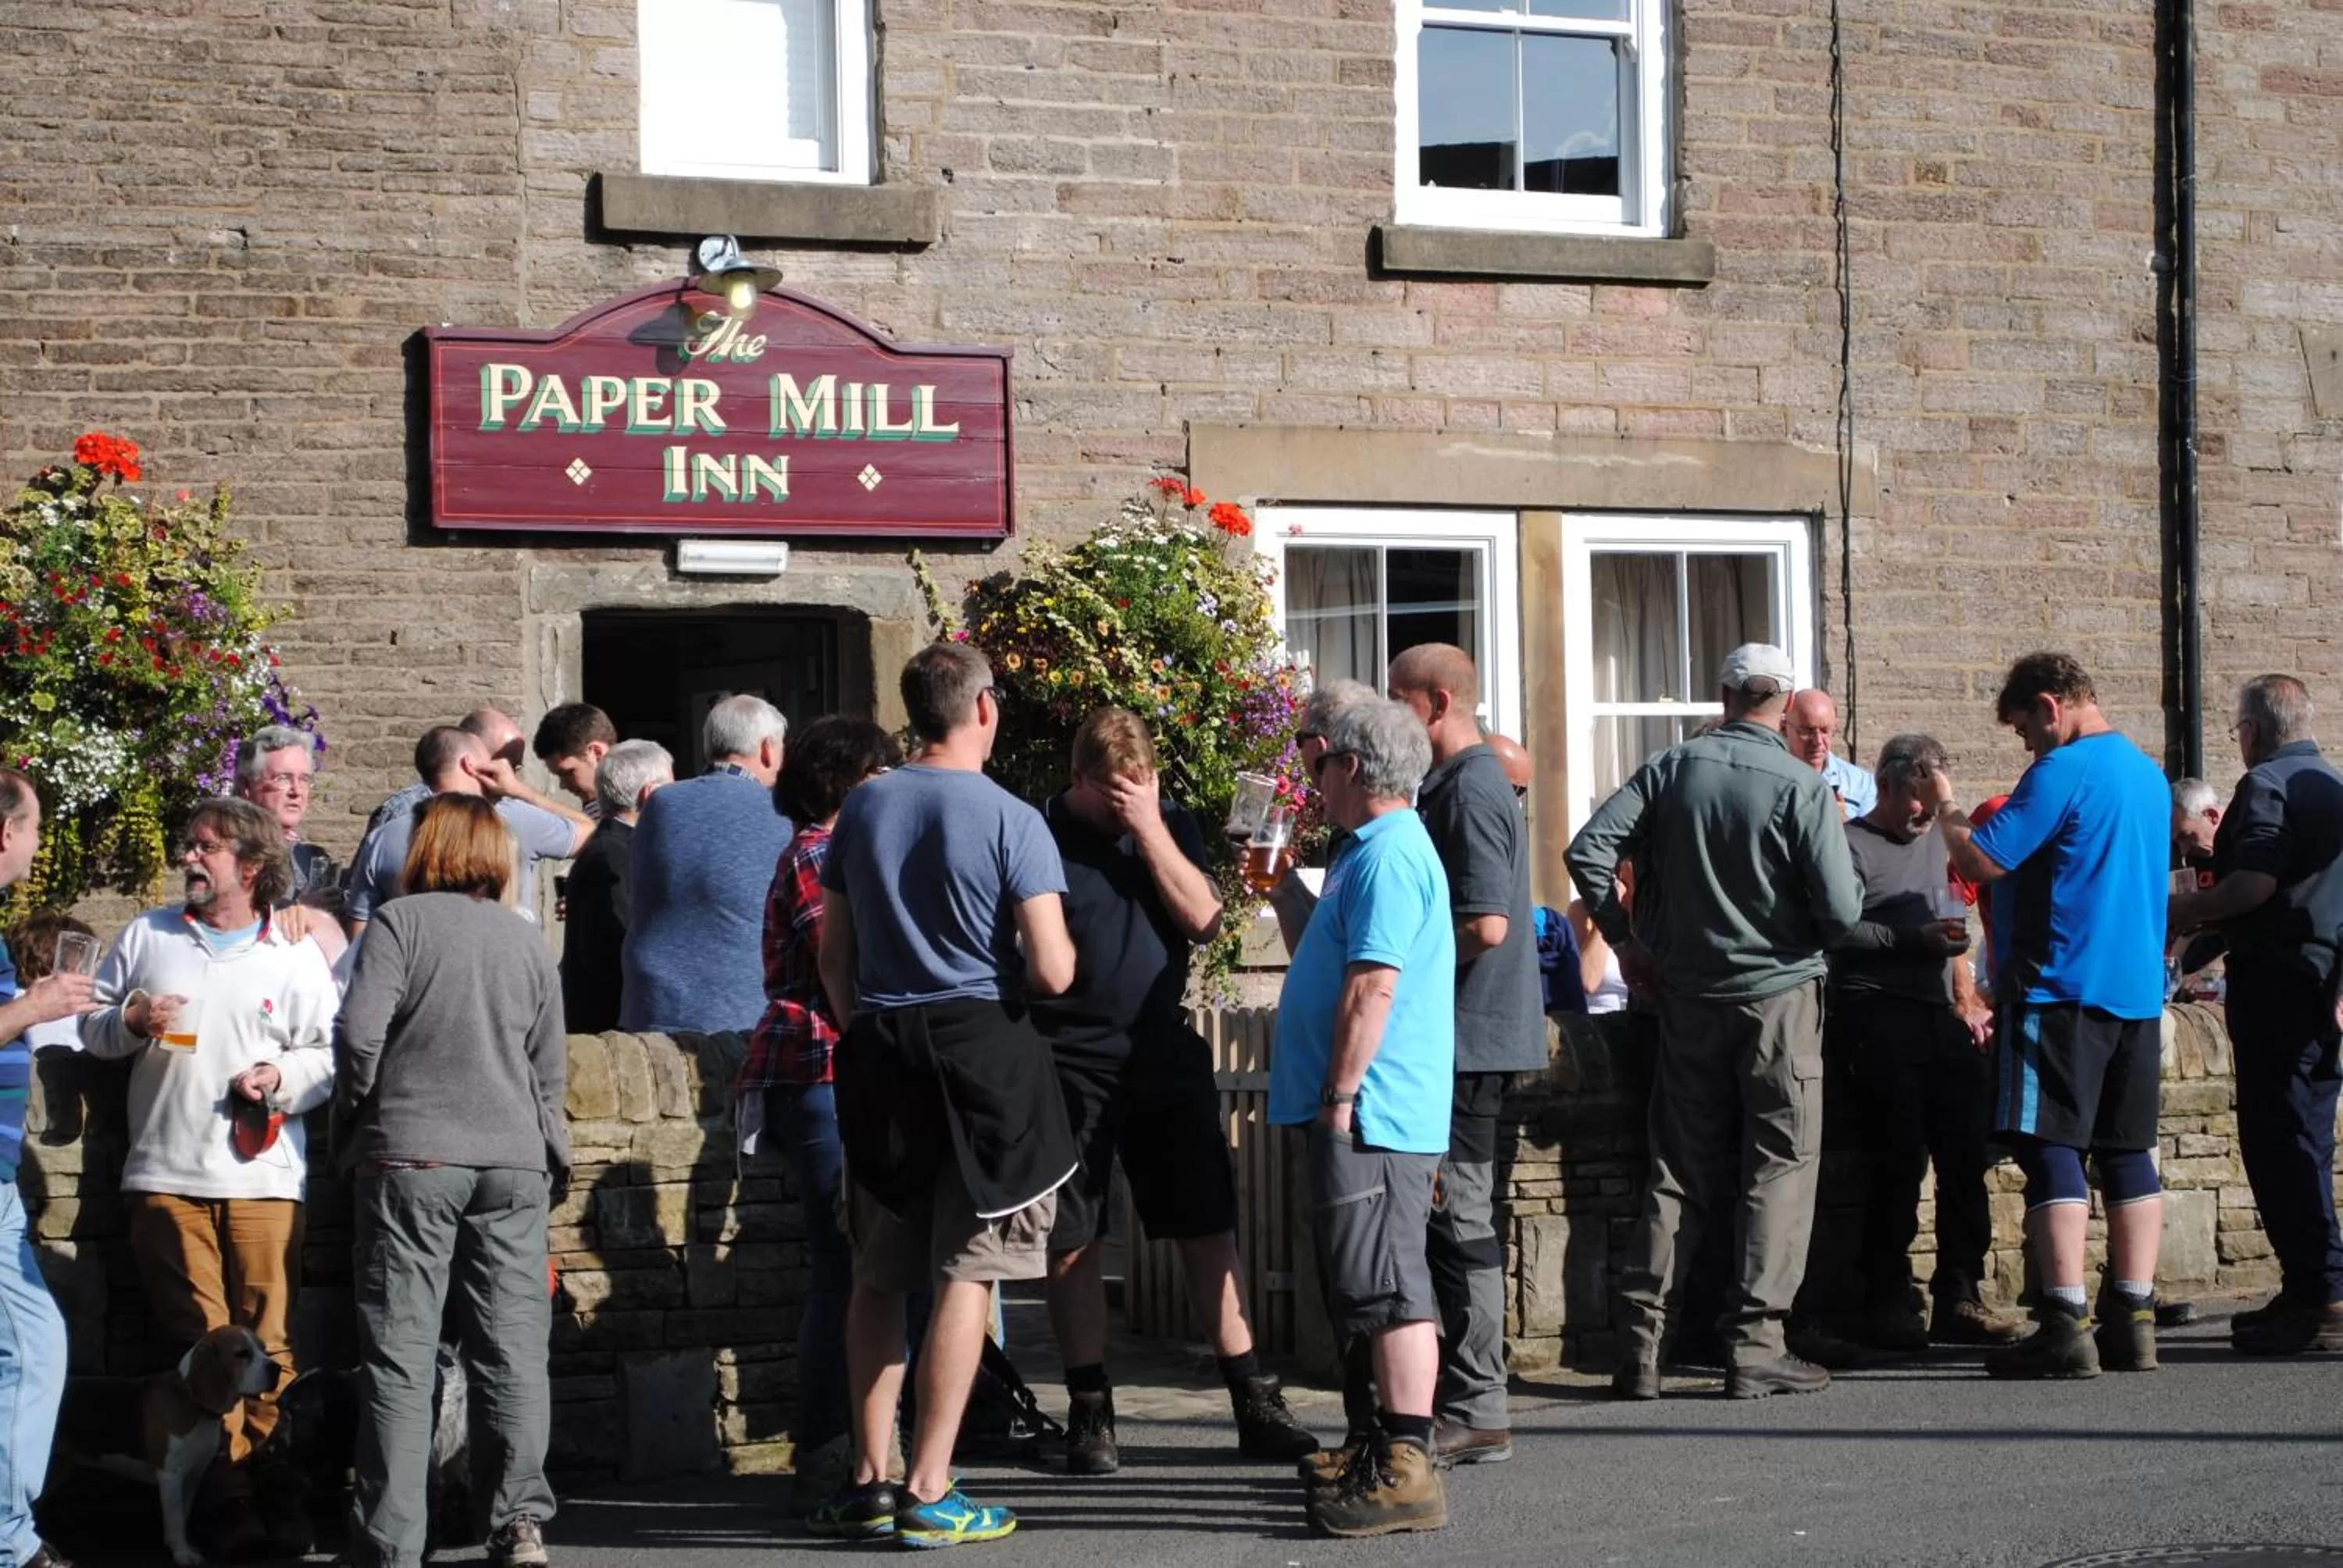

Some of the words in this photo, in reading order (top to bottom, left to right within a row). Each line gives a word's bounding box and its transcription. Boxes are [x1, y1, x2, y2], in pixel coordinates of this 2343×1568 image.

[679, 311, 766, 361] The
[479, 363, 726, 435] PAPER
[769, 373, 960, 440] MILL
[663, 446, 790, 502] INN
